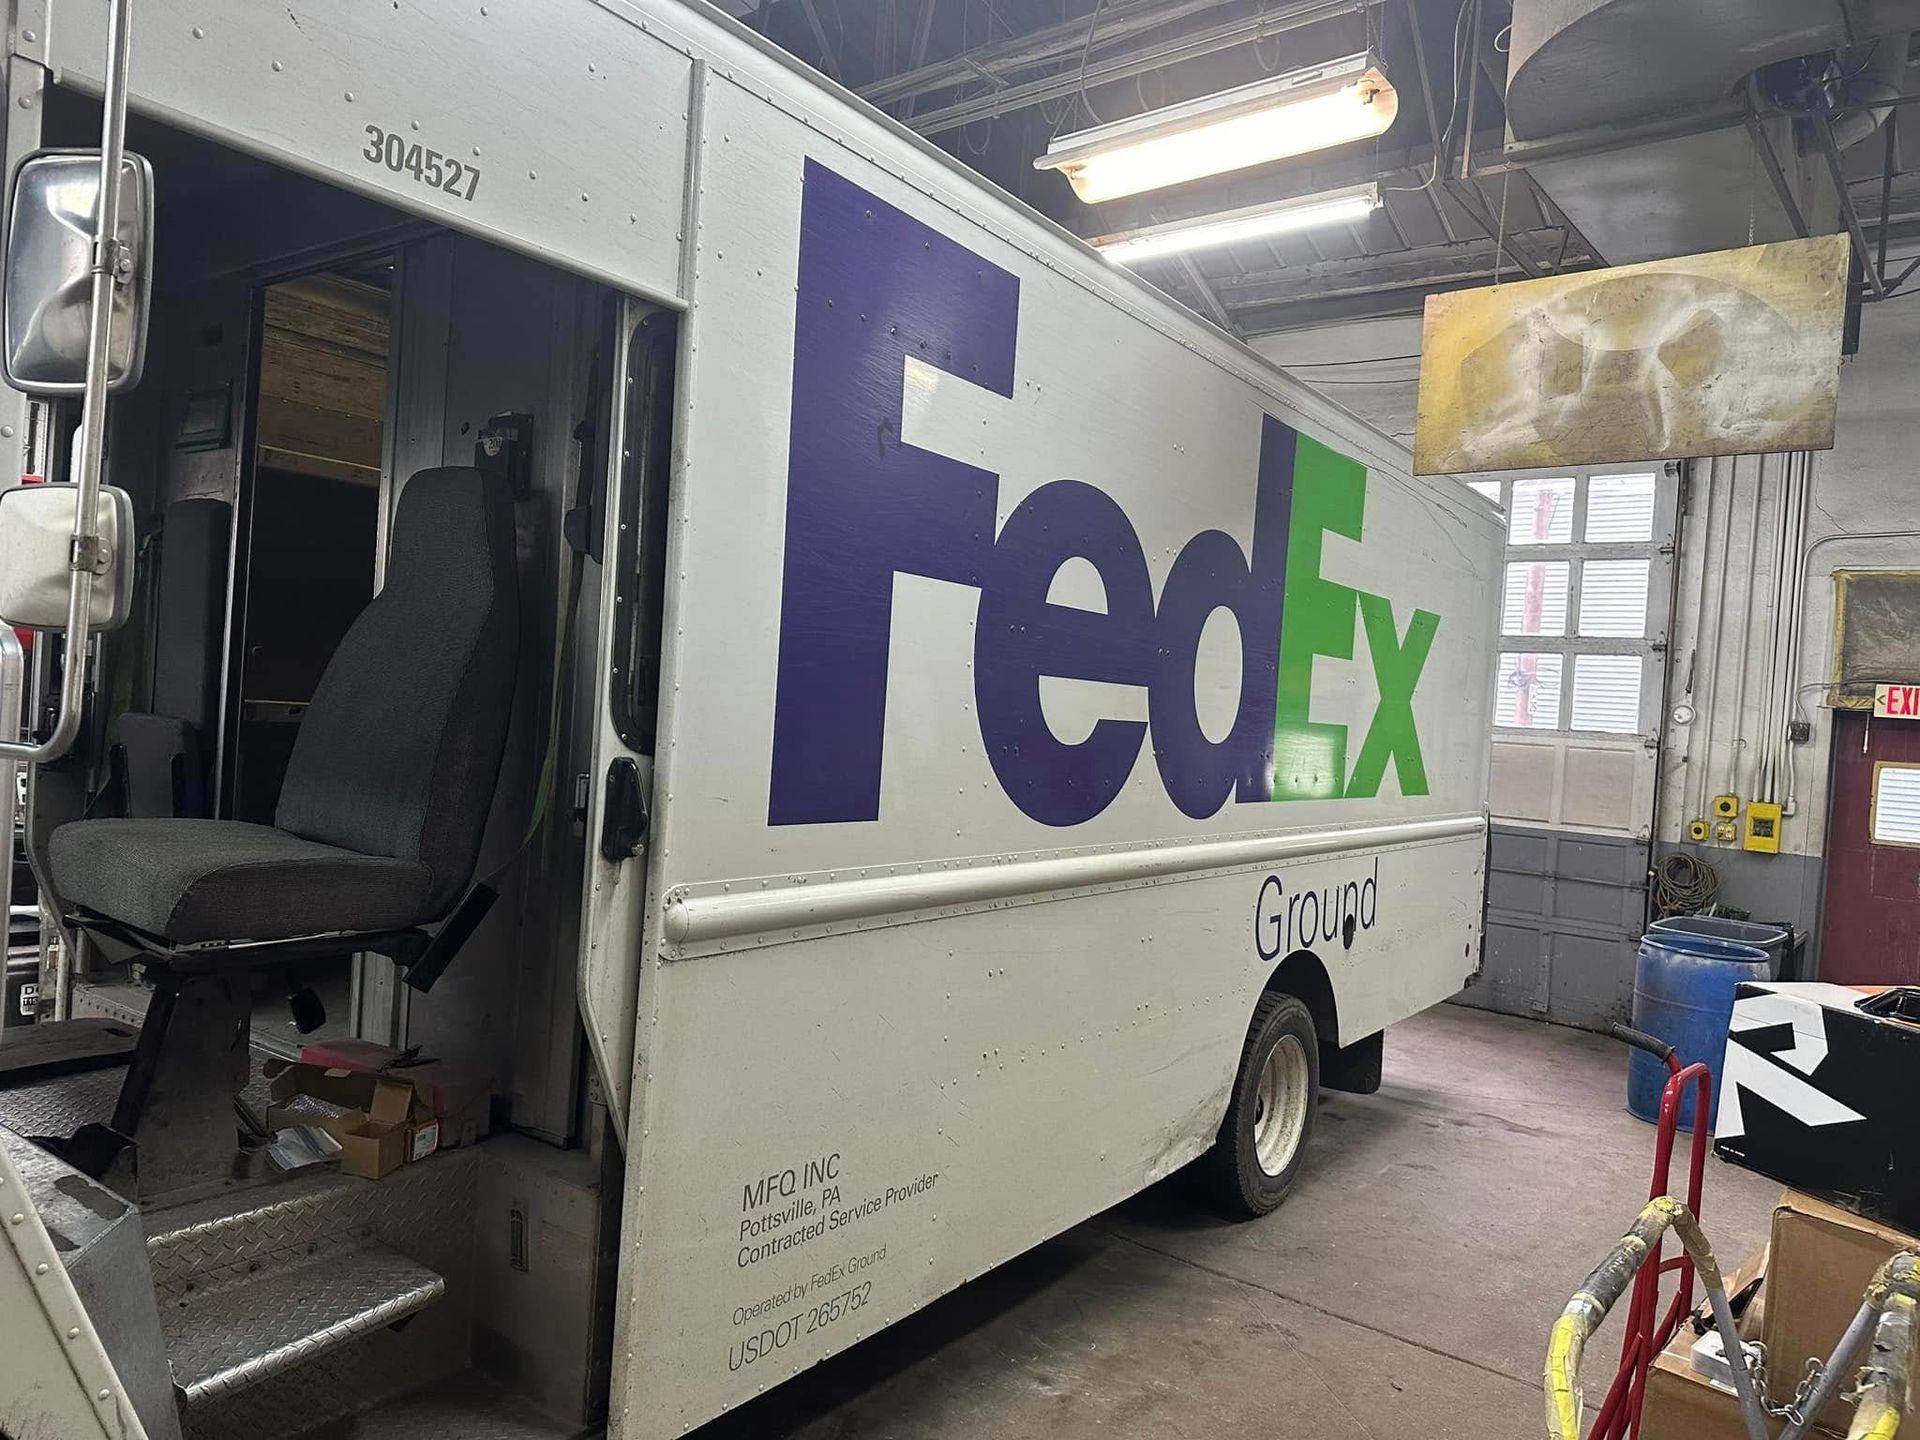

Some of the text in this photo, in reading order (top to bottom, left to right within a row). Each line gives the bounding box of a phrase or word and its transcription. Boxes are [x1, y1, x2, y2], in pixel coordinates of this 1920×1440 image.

[363, 124, 481, 201] 304527
[768, 155, 1442, 827] FedEx
[1887, 686, 1920, 716] EXI
[1255, 856, 1379, 962] Ground
[737, 1173, 940, 1269] Contracted Service Provider
[739, 1185, 841, 1242] Pottsville, PA
[742, 1153, 841, 1213] MFQ INC
[728, 1280, 873, 1372] USDOT 265752
[732, 1244, 888, 1327] Operated by FedEx Ground
